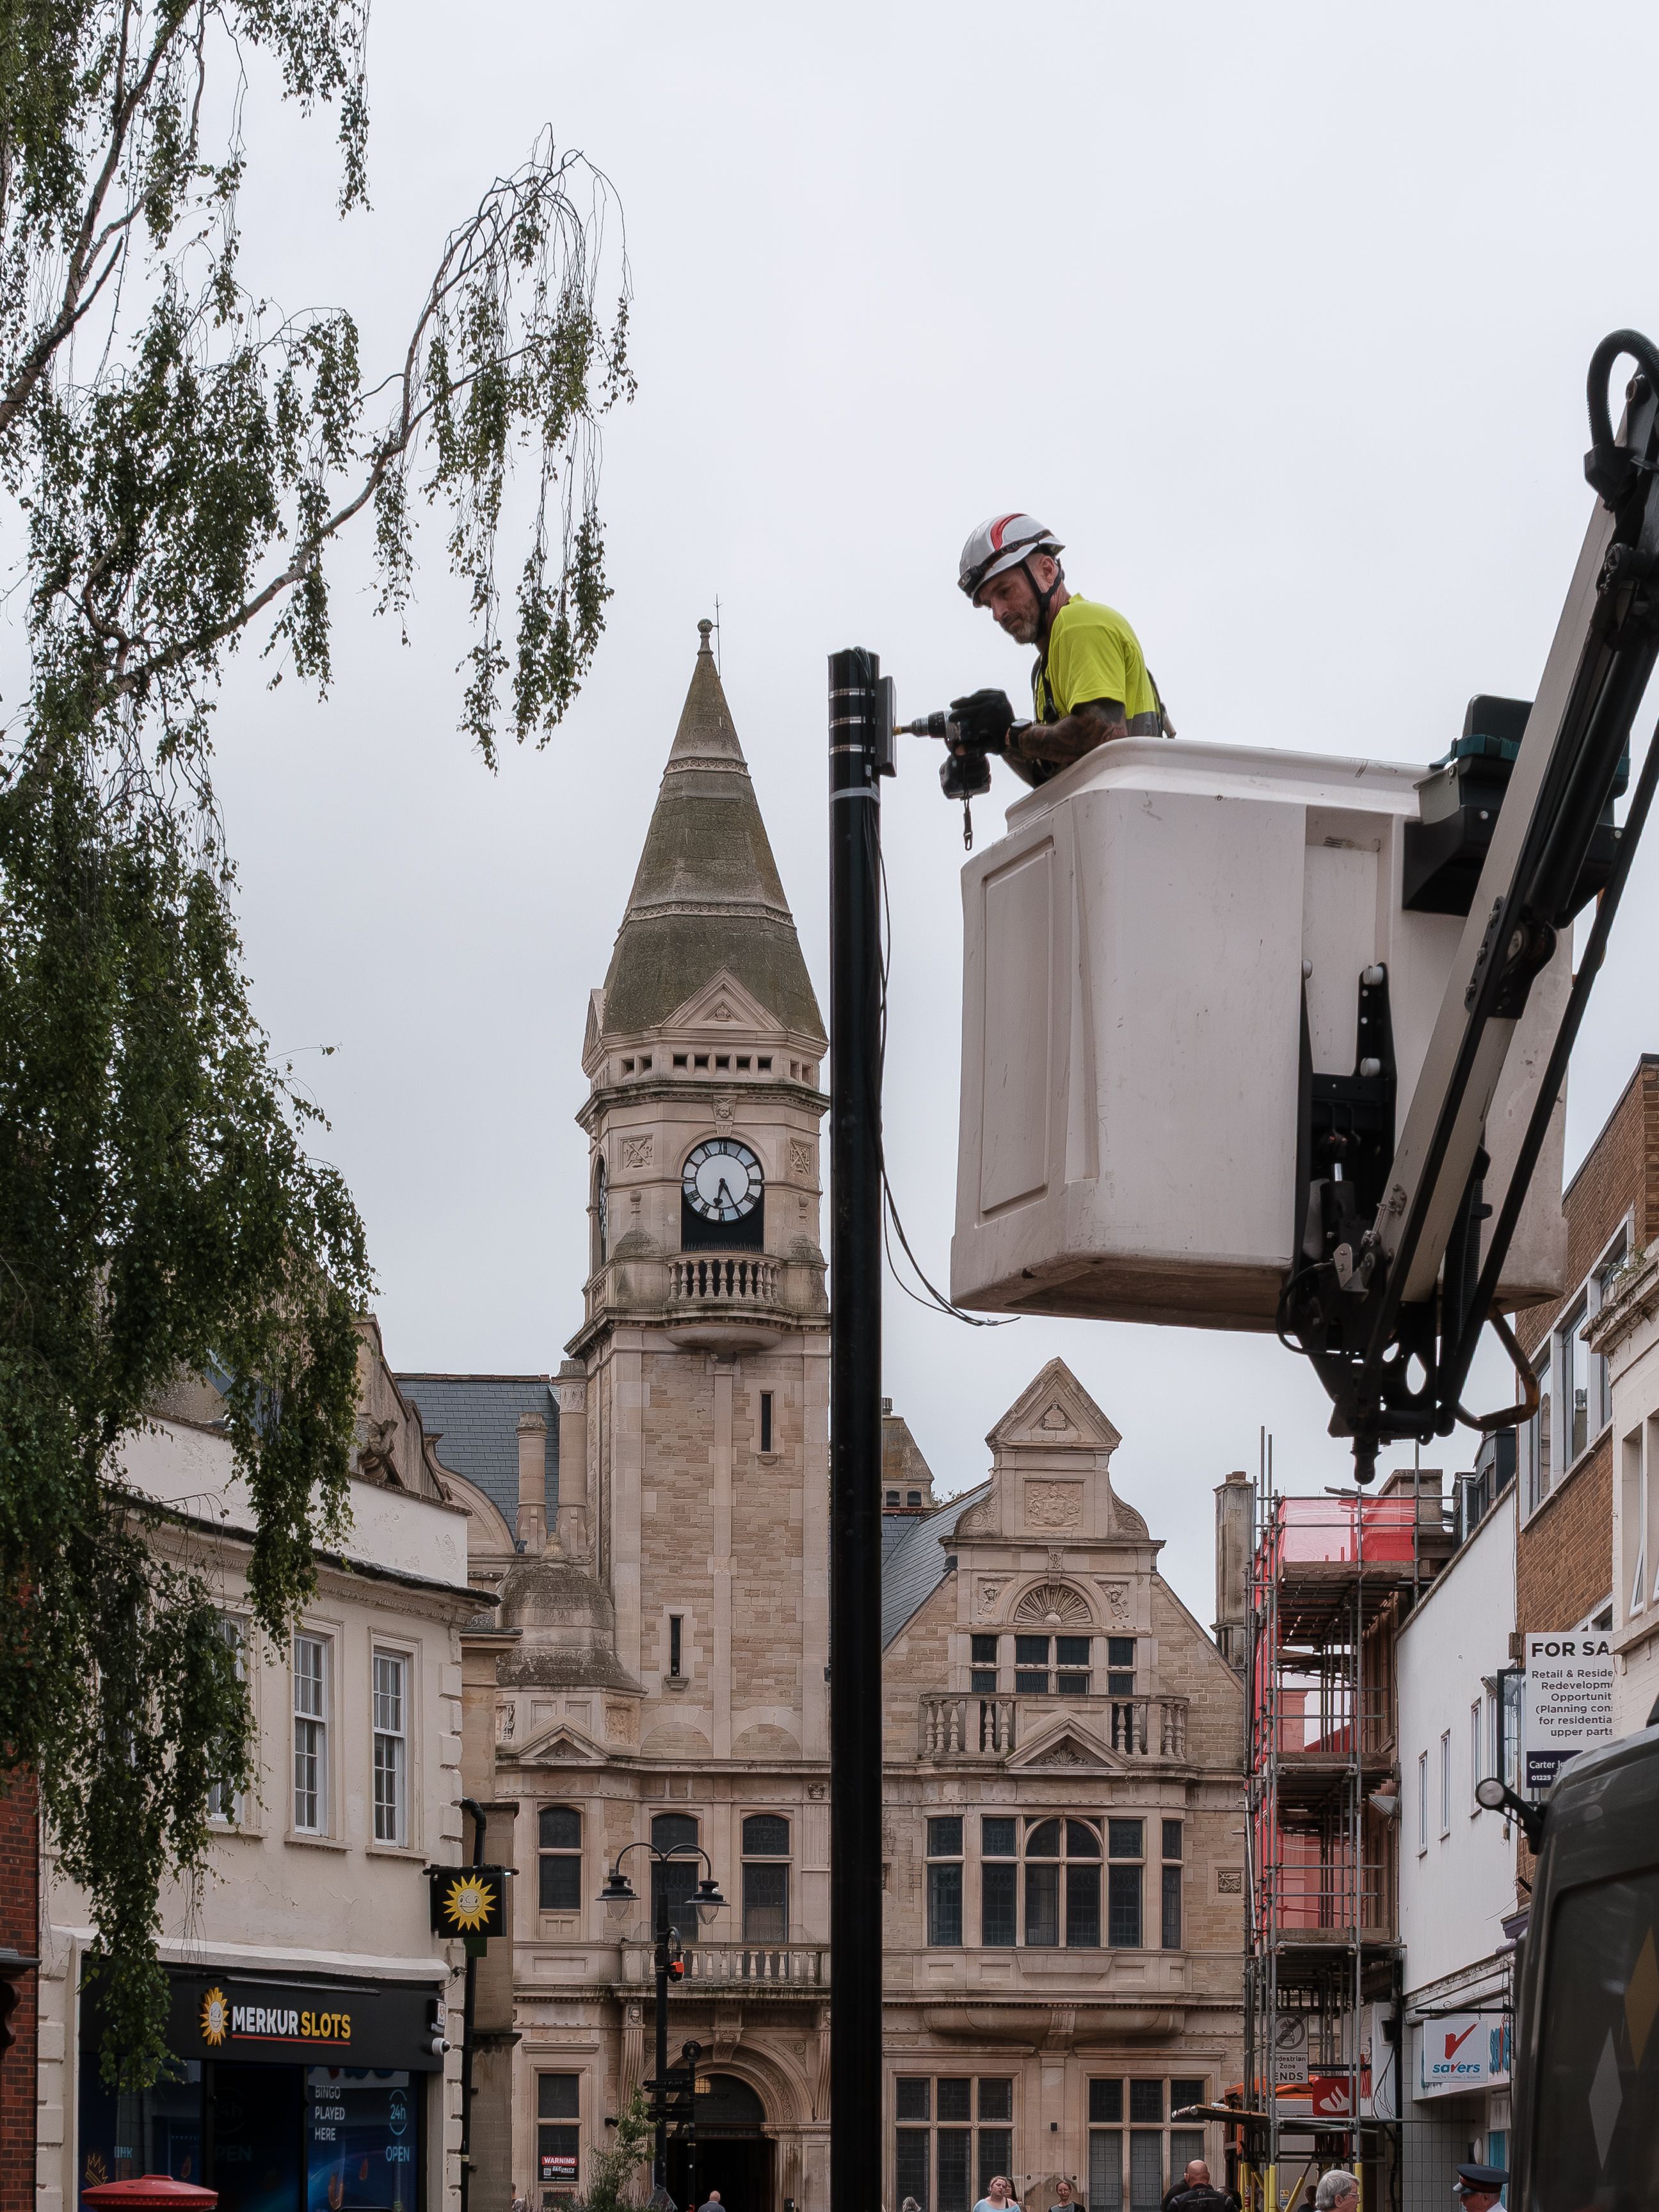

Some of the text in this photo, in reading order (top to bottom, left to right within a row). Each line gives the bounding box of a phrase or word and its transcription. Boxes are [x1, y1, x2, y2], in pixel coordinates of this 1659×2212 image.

[1532, 1642, 1576, 1657] FOR
[1532, 1669, 1563, 1679] Retail
[1566, 1669, 1574, 1678] &
[1551, 1692, 1613, 1703] Opportunit
[1536, 1704, 1587, 1714] (Planning
[1539, 1716, 1555, 1724] for
[1551, 1729, 1583, 1738] upper
[232, 2006, 351, 2039] MERKUR SLOTS
[1432, 2061, 1480, 2073] savers
[315, 2085, 341, 2099] BINGO
[315, 2106, 345, 2120] PLAYED
[390, 2104, 406, 2120] 24h
[315, 2127, 336, 2141] HERE
[386, 2145, 410, 2162] OPEN
